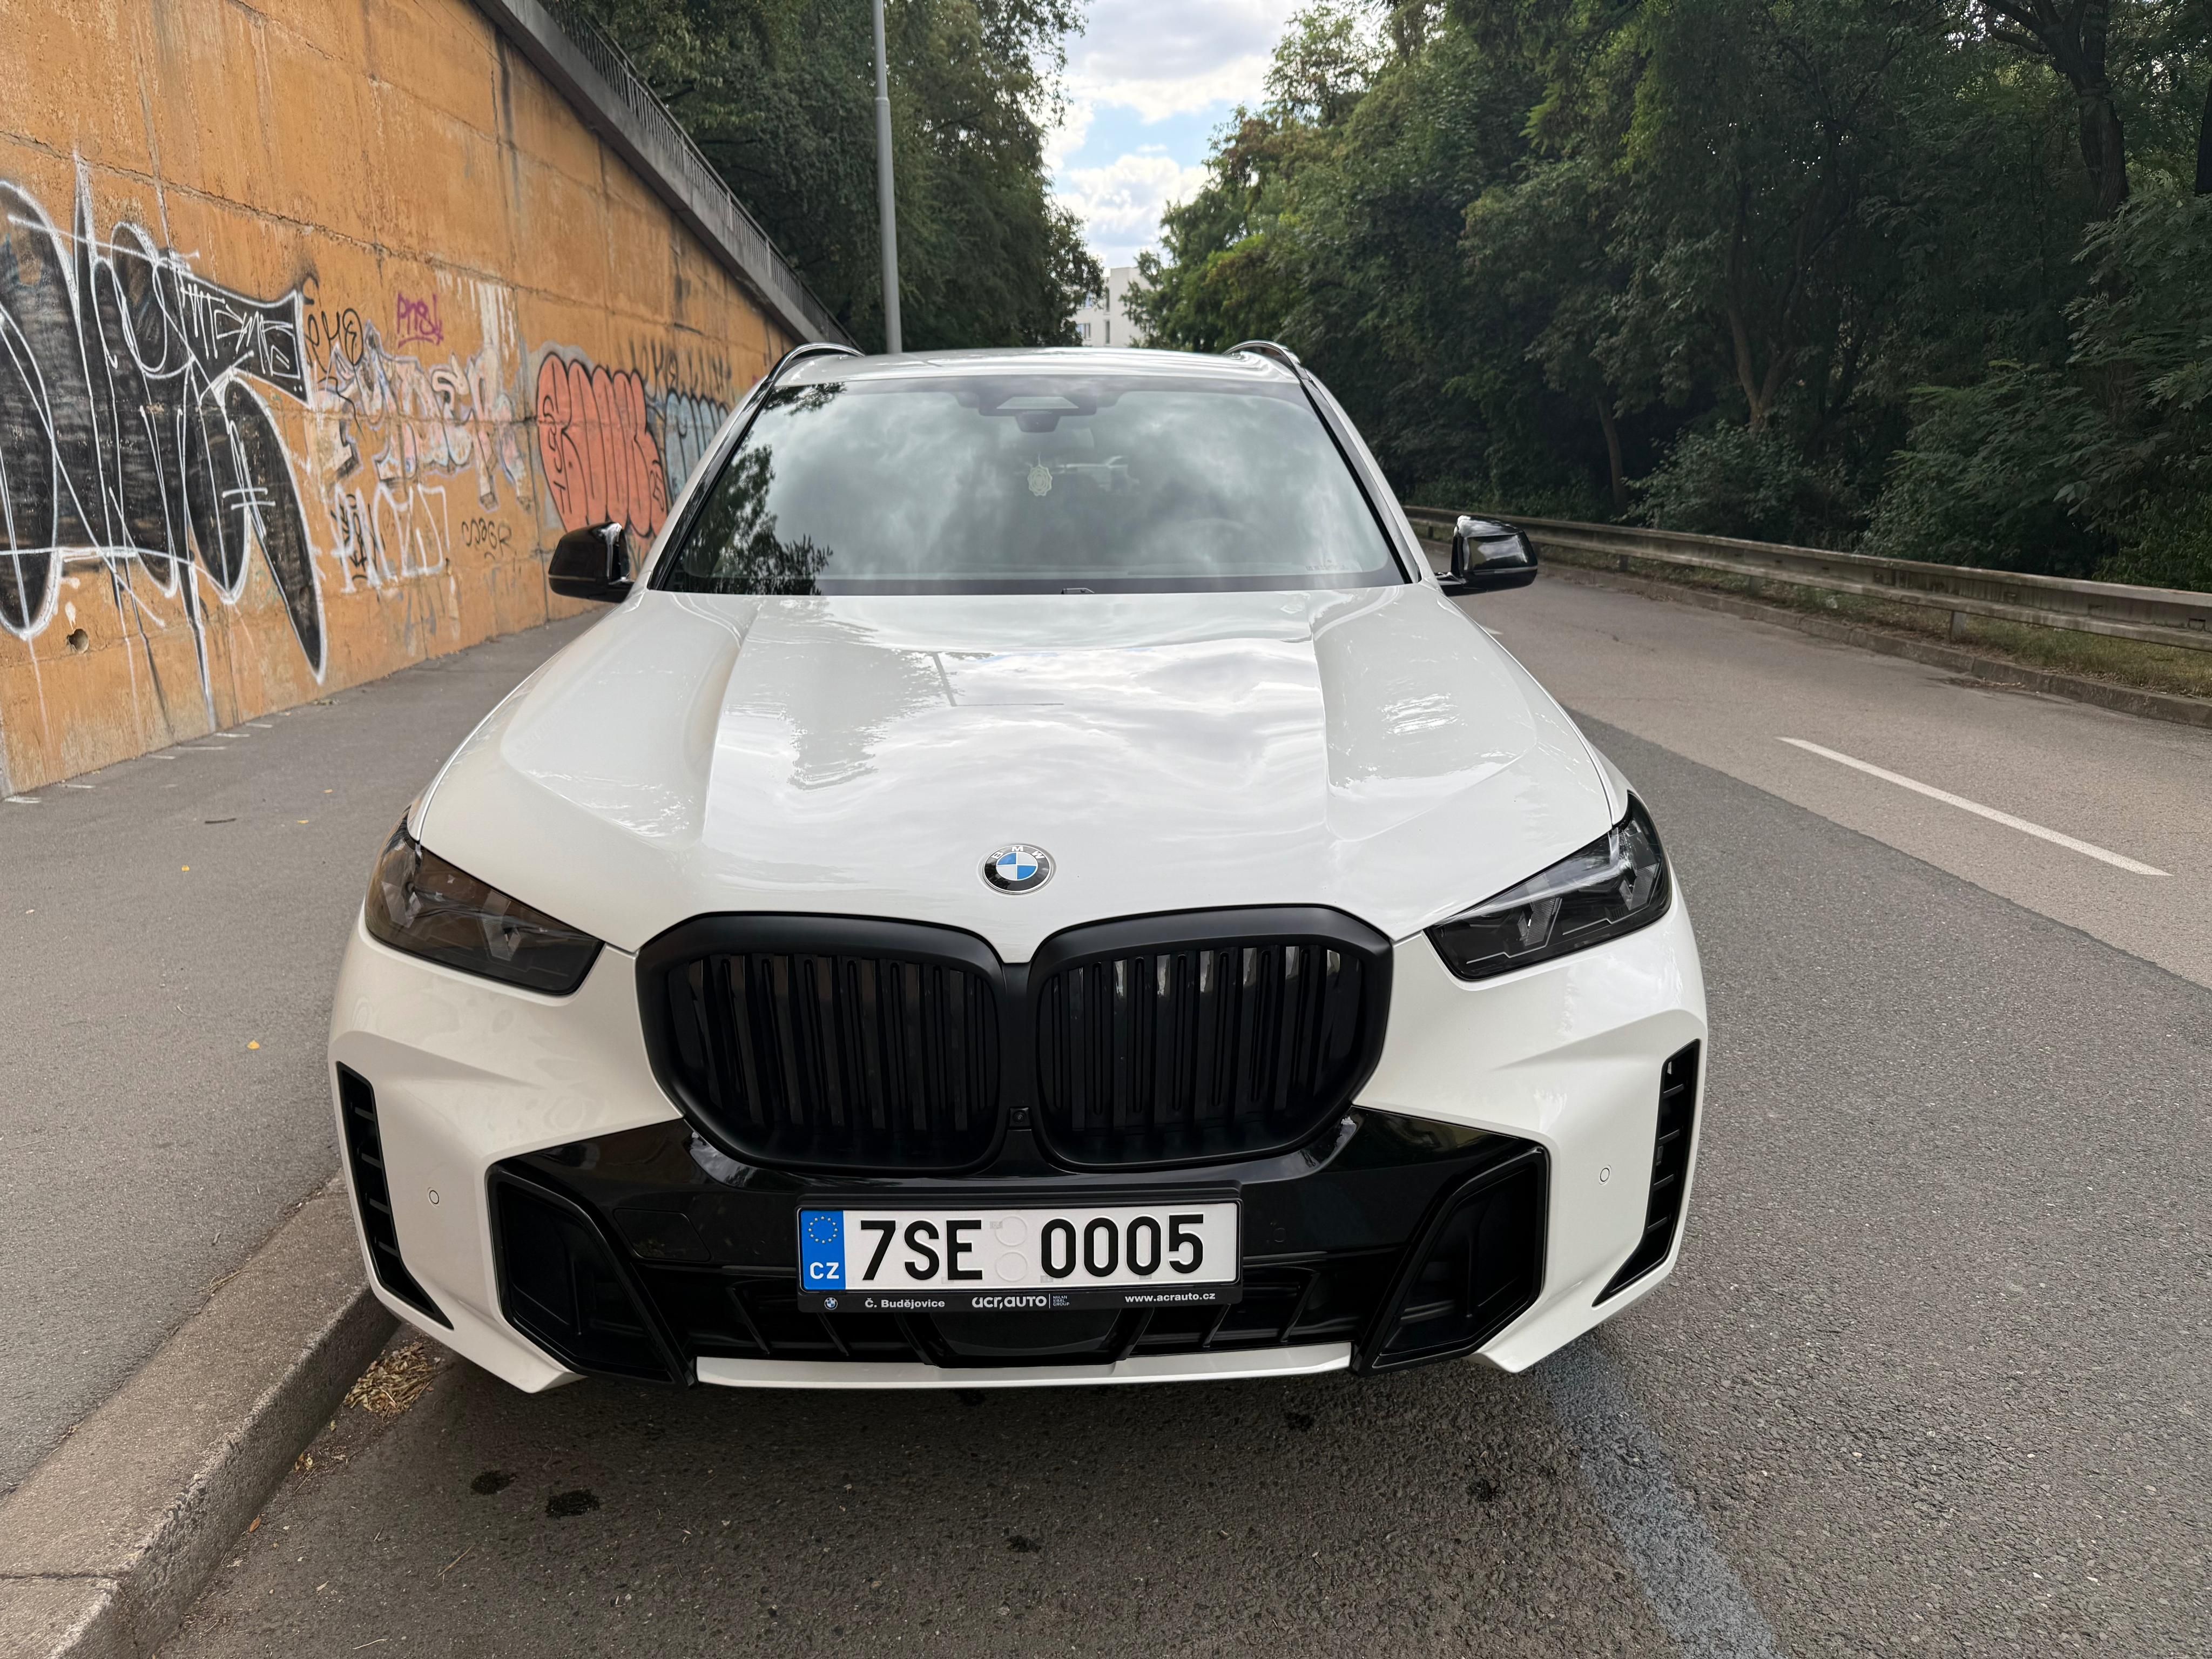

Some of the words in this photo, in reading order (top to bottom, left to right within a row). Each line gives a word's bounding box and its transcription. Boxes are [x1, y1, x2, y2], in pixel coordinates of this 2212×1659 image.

[991, 846, 1045, 859] BMW
[861, 1219, 983, 1280] 7SE
[1041, 1214, 1203, 1278] 0005
[810, 1262, 839, 1279] CZ
[865, 1298, 878, 1308] Č.
[881, 1299, 945, 1309] Budějovice
[1125, 1292, 1216, 1303] www.acrauto.cz
